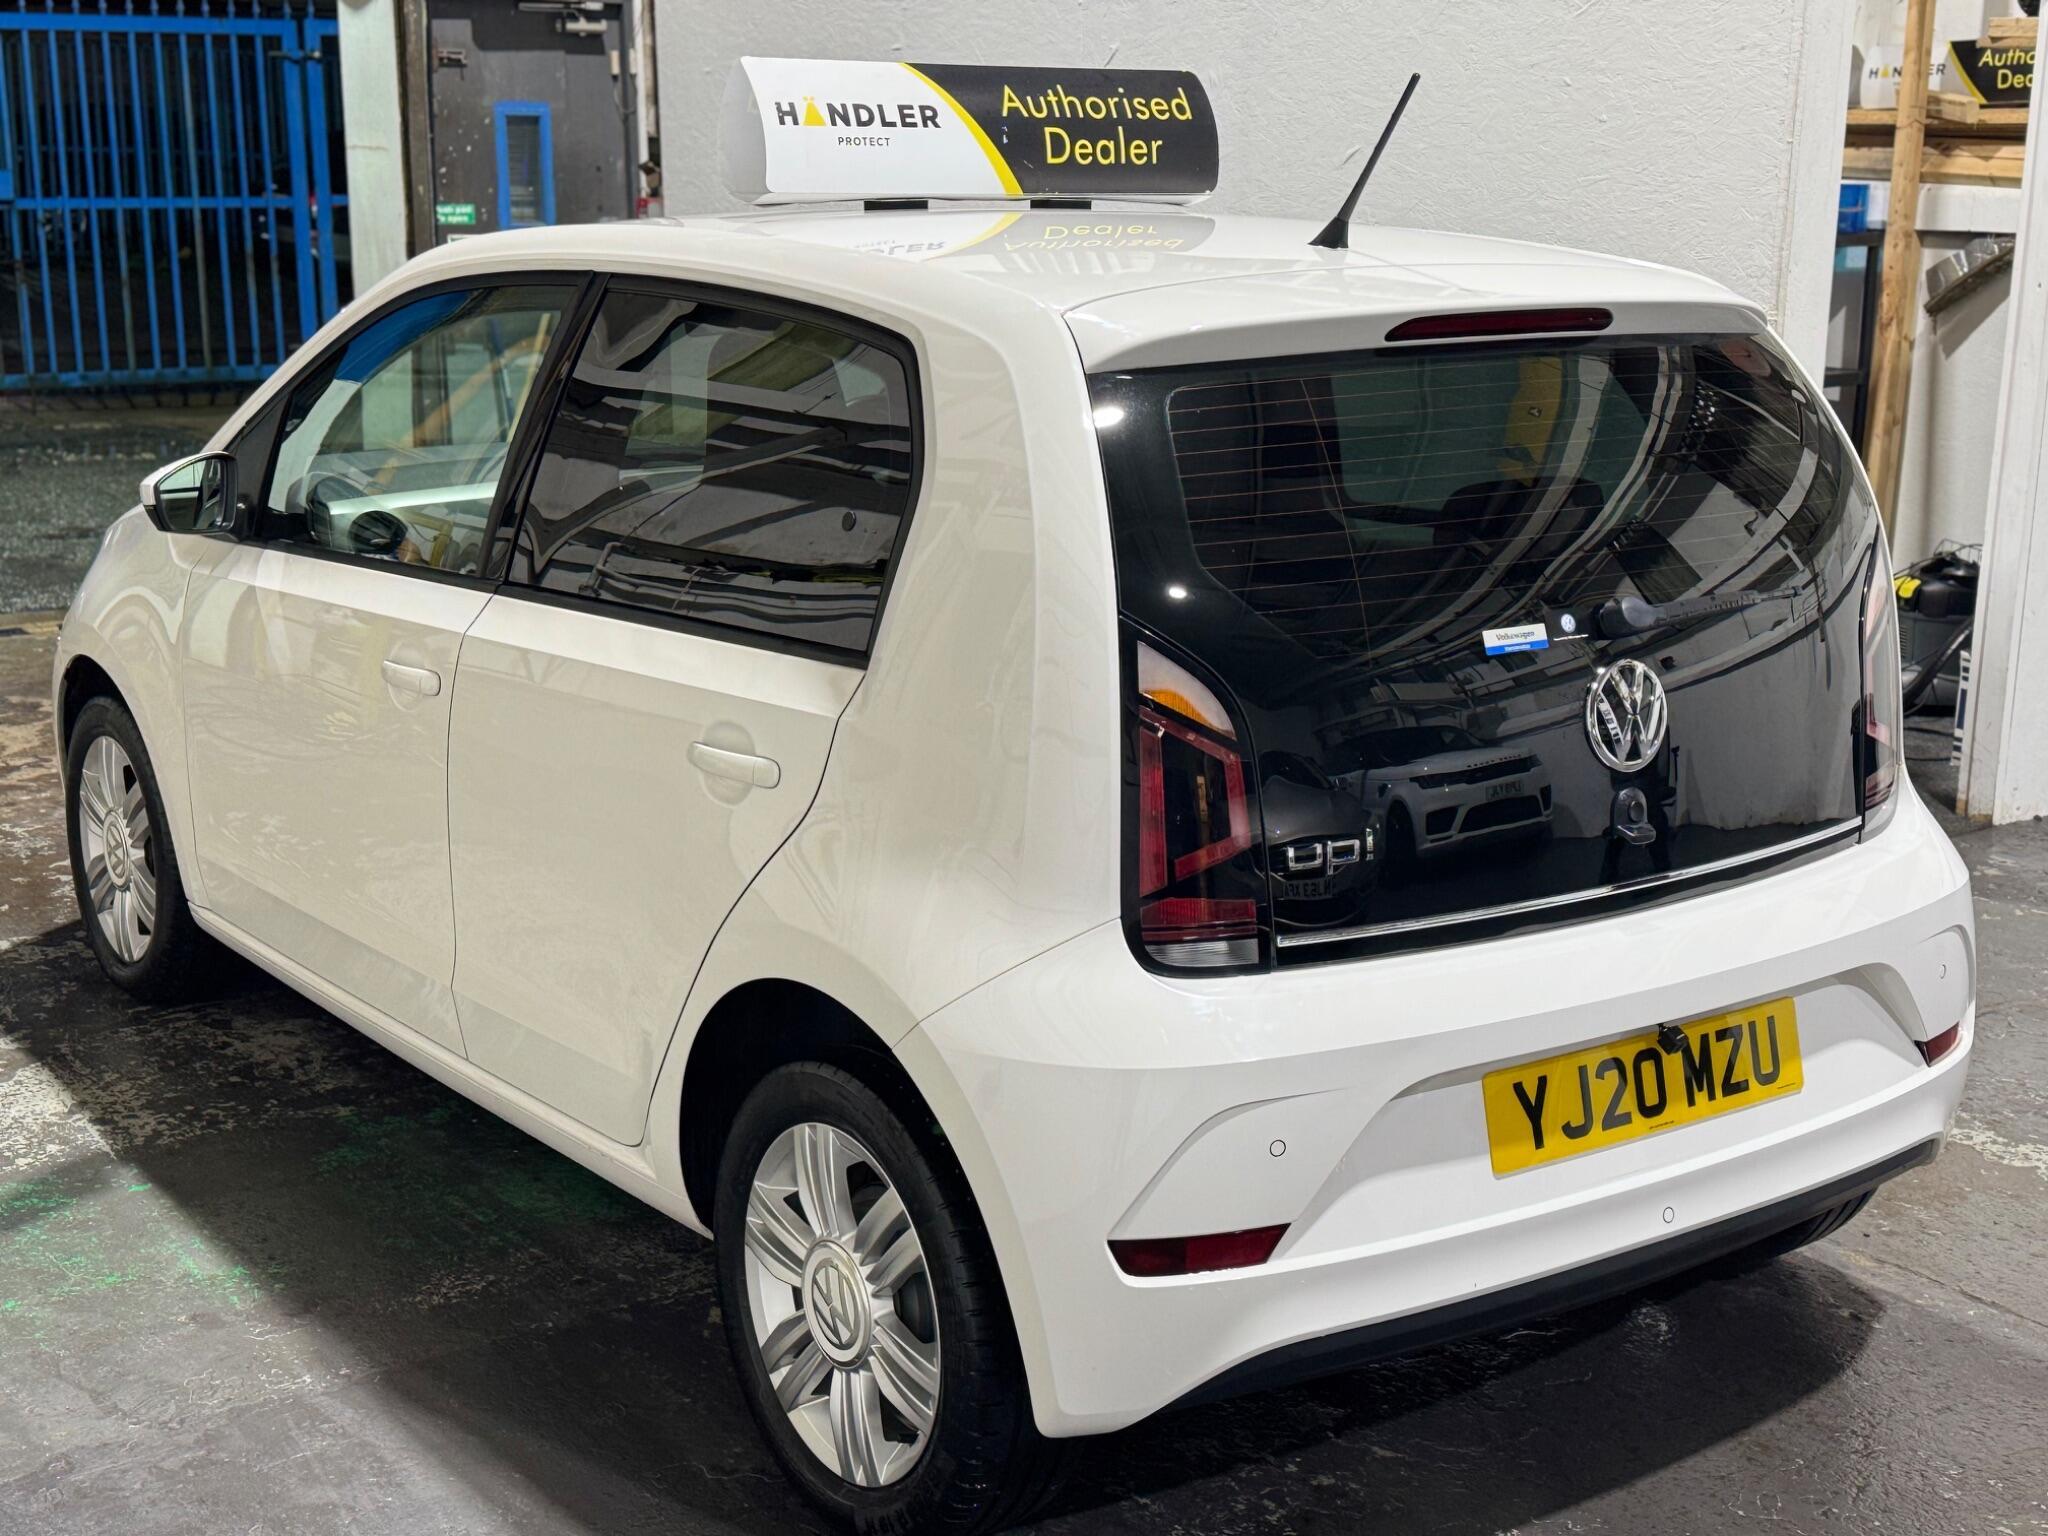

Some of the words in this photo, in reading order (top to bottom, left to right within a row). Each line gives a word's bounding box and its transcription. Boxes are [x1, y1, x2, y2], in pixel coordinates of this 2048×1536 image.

[1002, 84, 1193, 121] Authorised
[838, 136, 891, 147] PROTECT
[1043, 126, 1163, 165] Dealer
[1287, 828, 1375, 876] up!
[1512, 1047, 1667, 1150] YJ20
[1680, 1015, 1781, 1107] MZU
